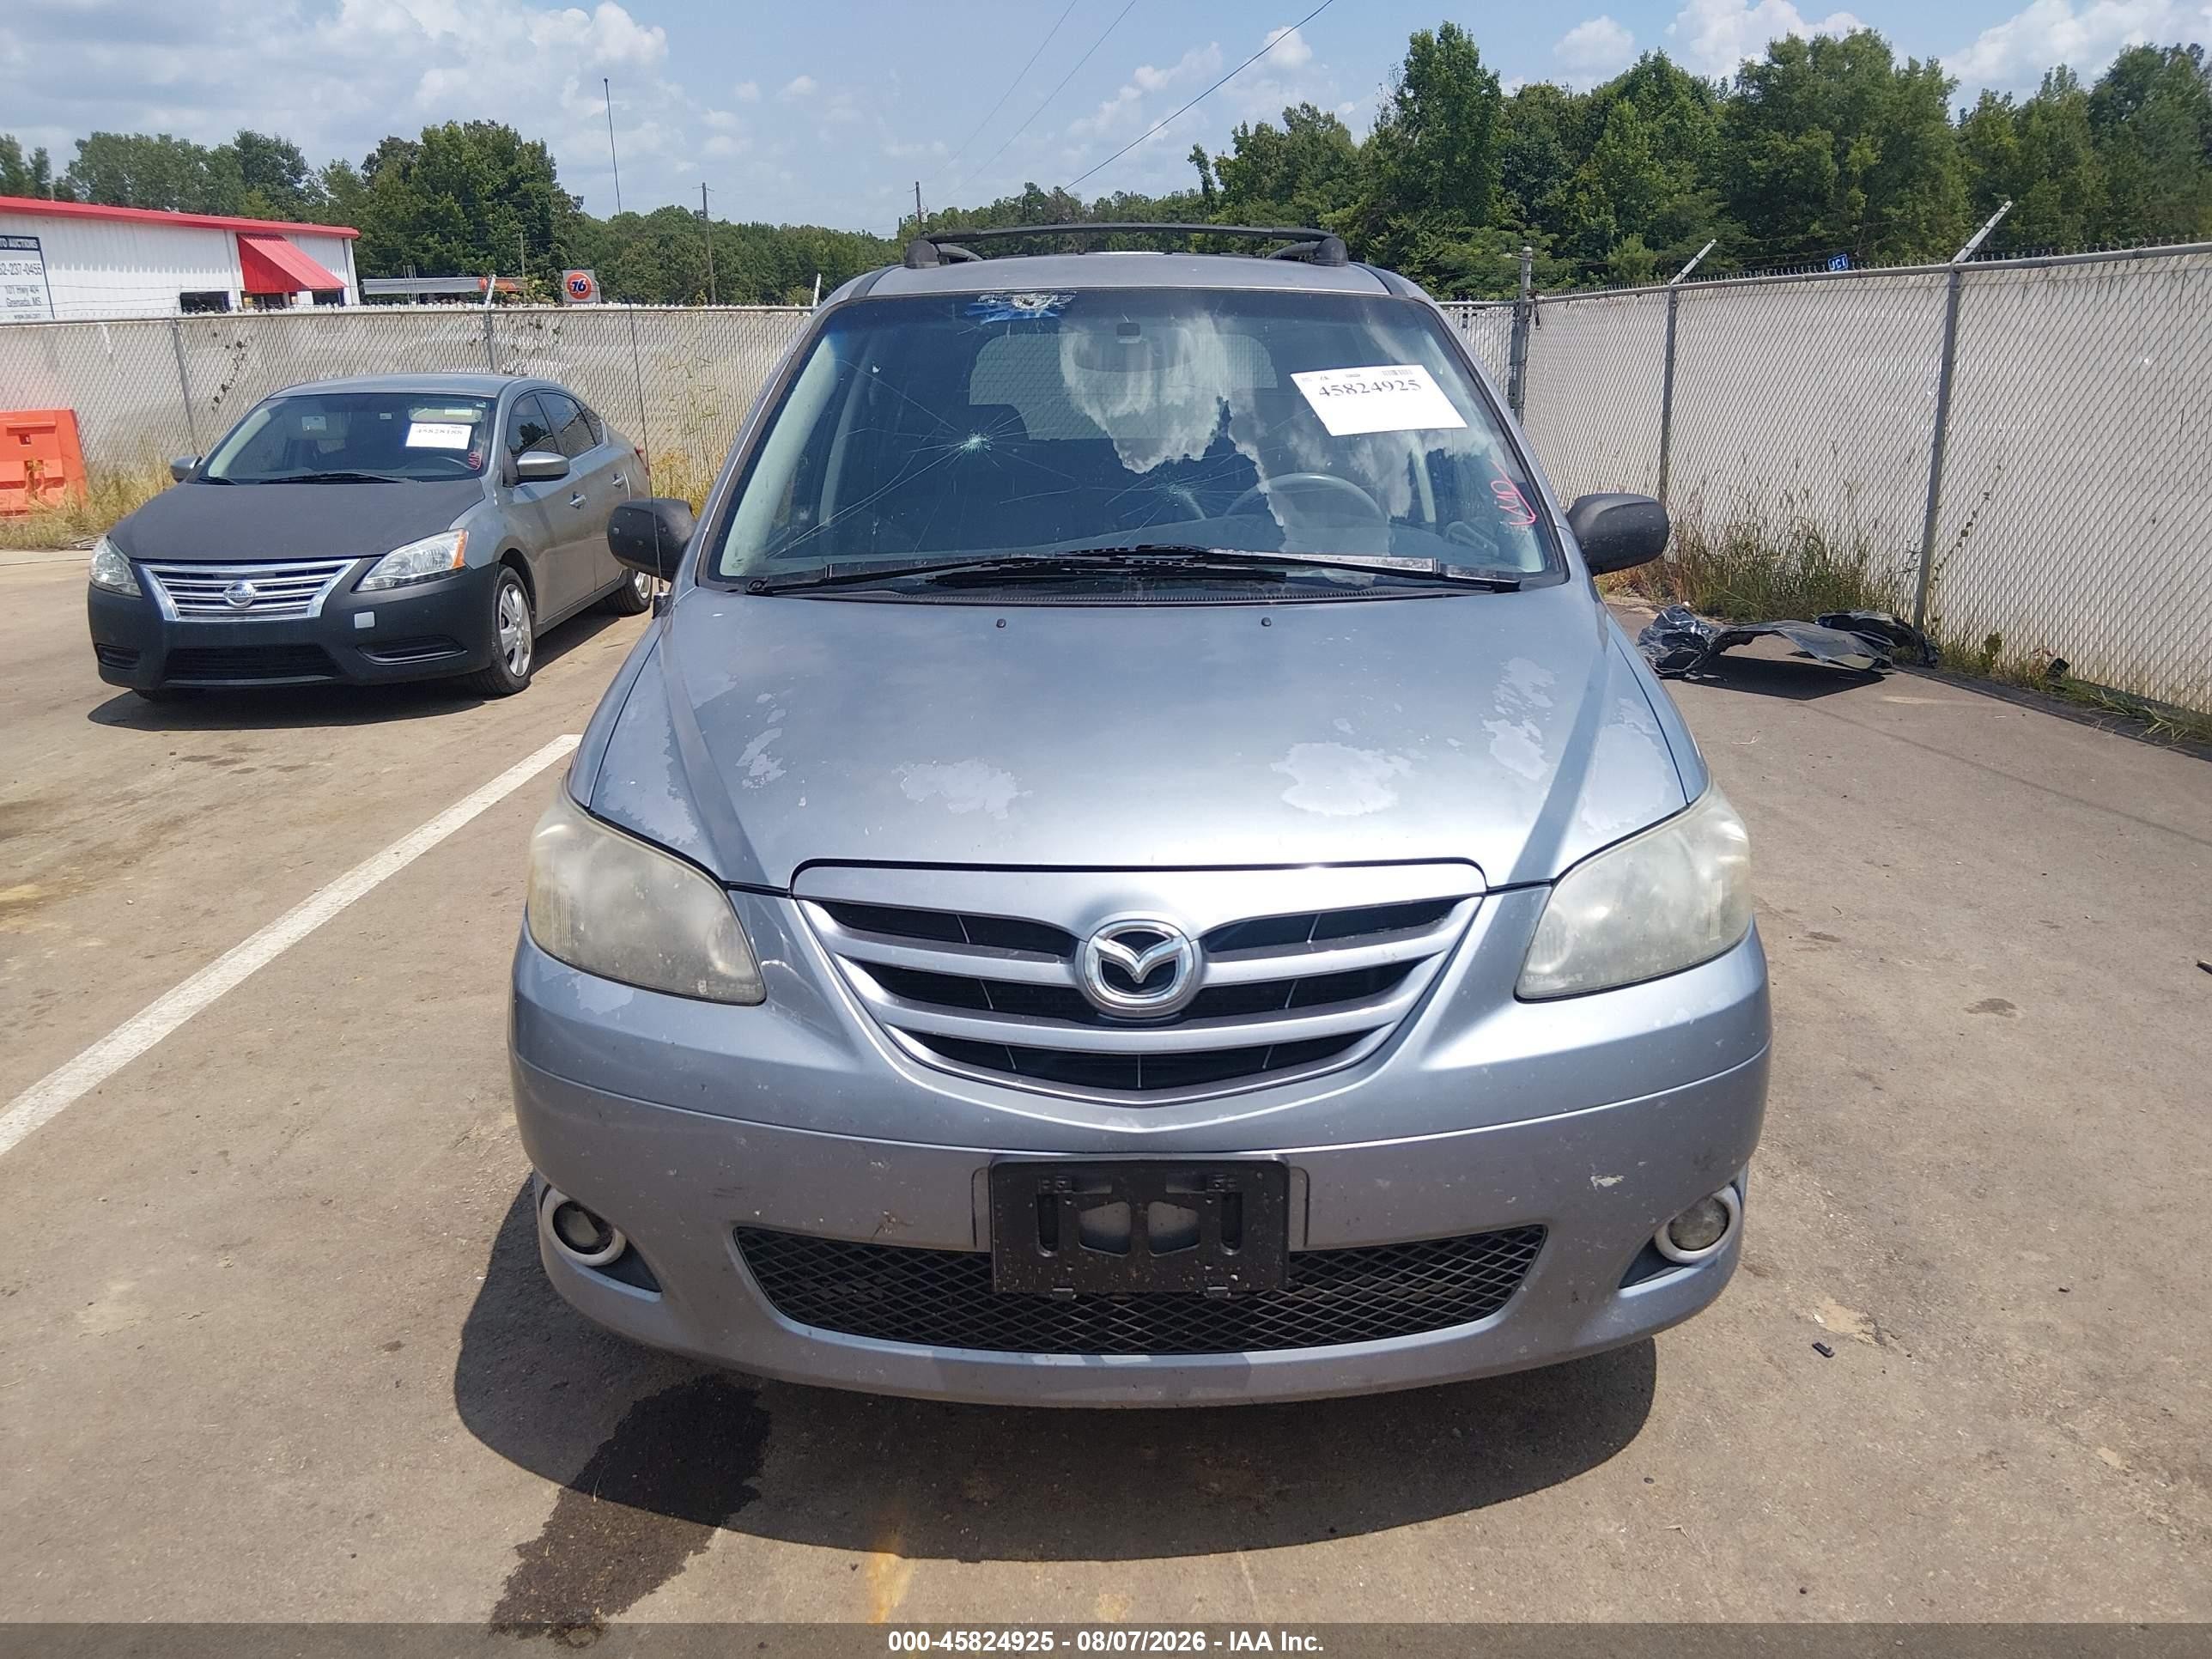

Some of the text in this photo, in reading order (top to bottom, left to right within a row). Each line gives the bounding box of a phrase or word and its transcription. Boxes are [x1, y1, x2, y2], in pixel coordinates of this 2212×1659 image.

[9, 239, 39, 249] AUCTIONS
[569, 277, 587, 293] 76
[1318, 379, 1422, 398] 45824925
